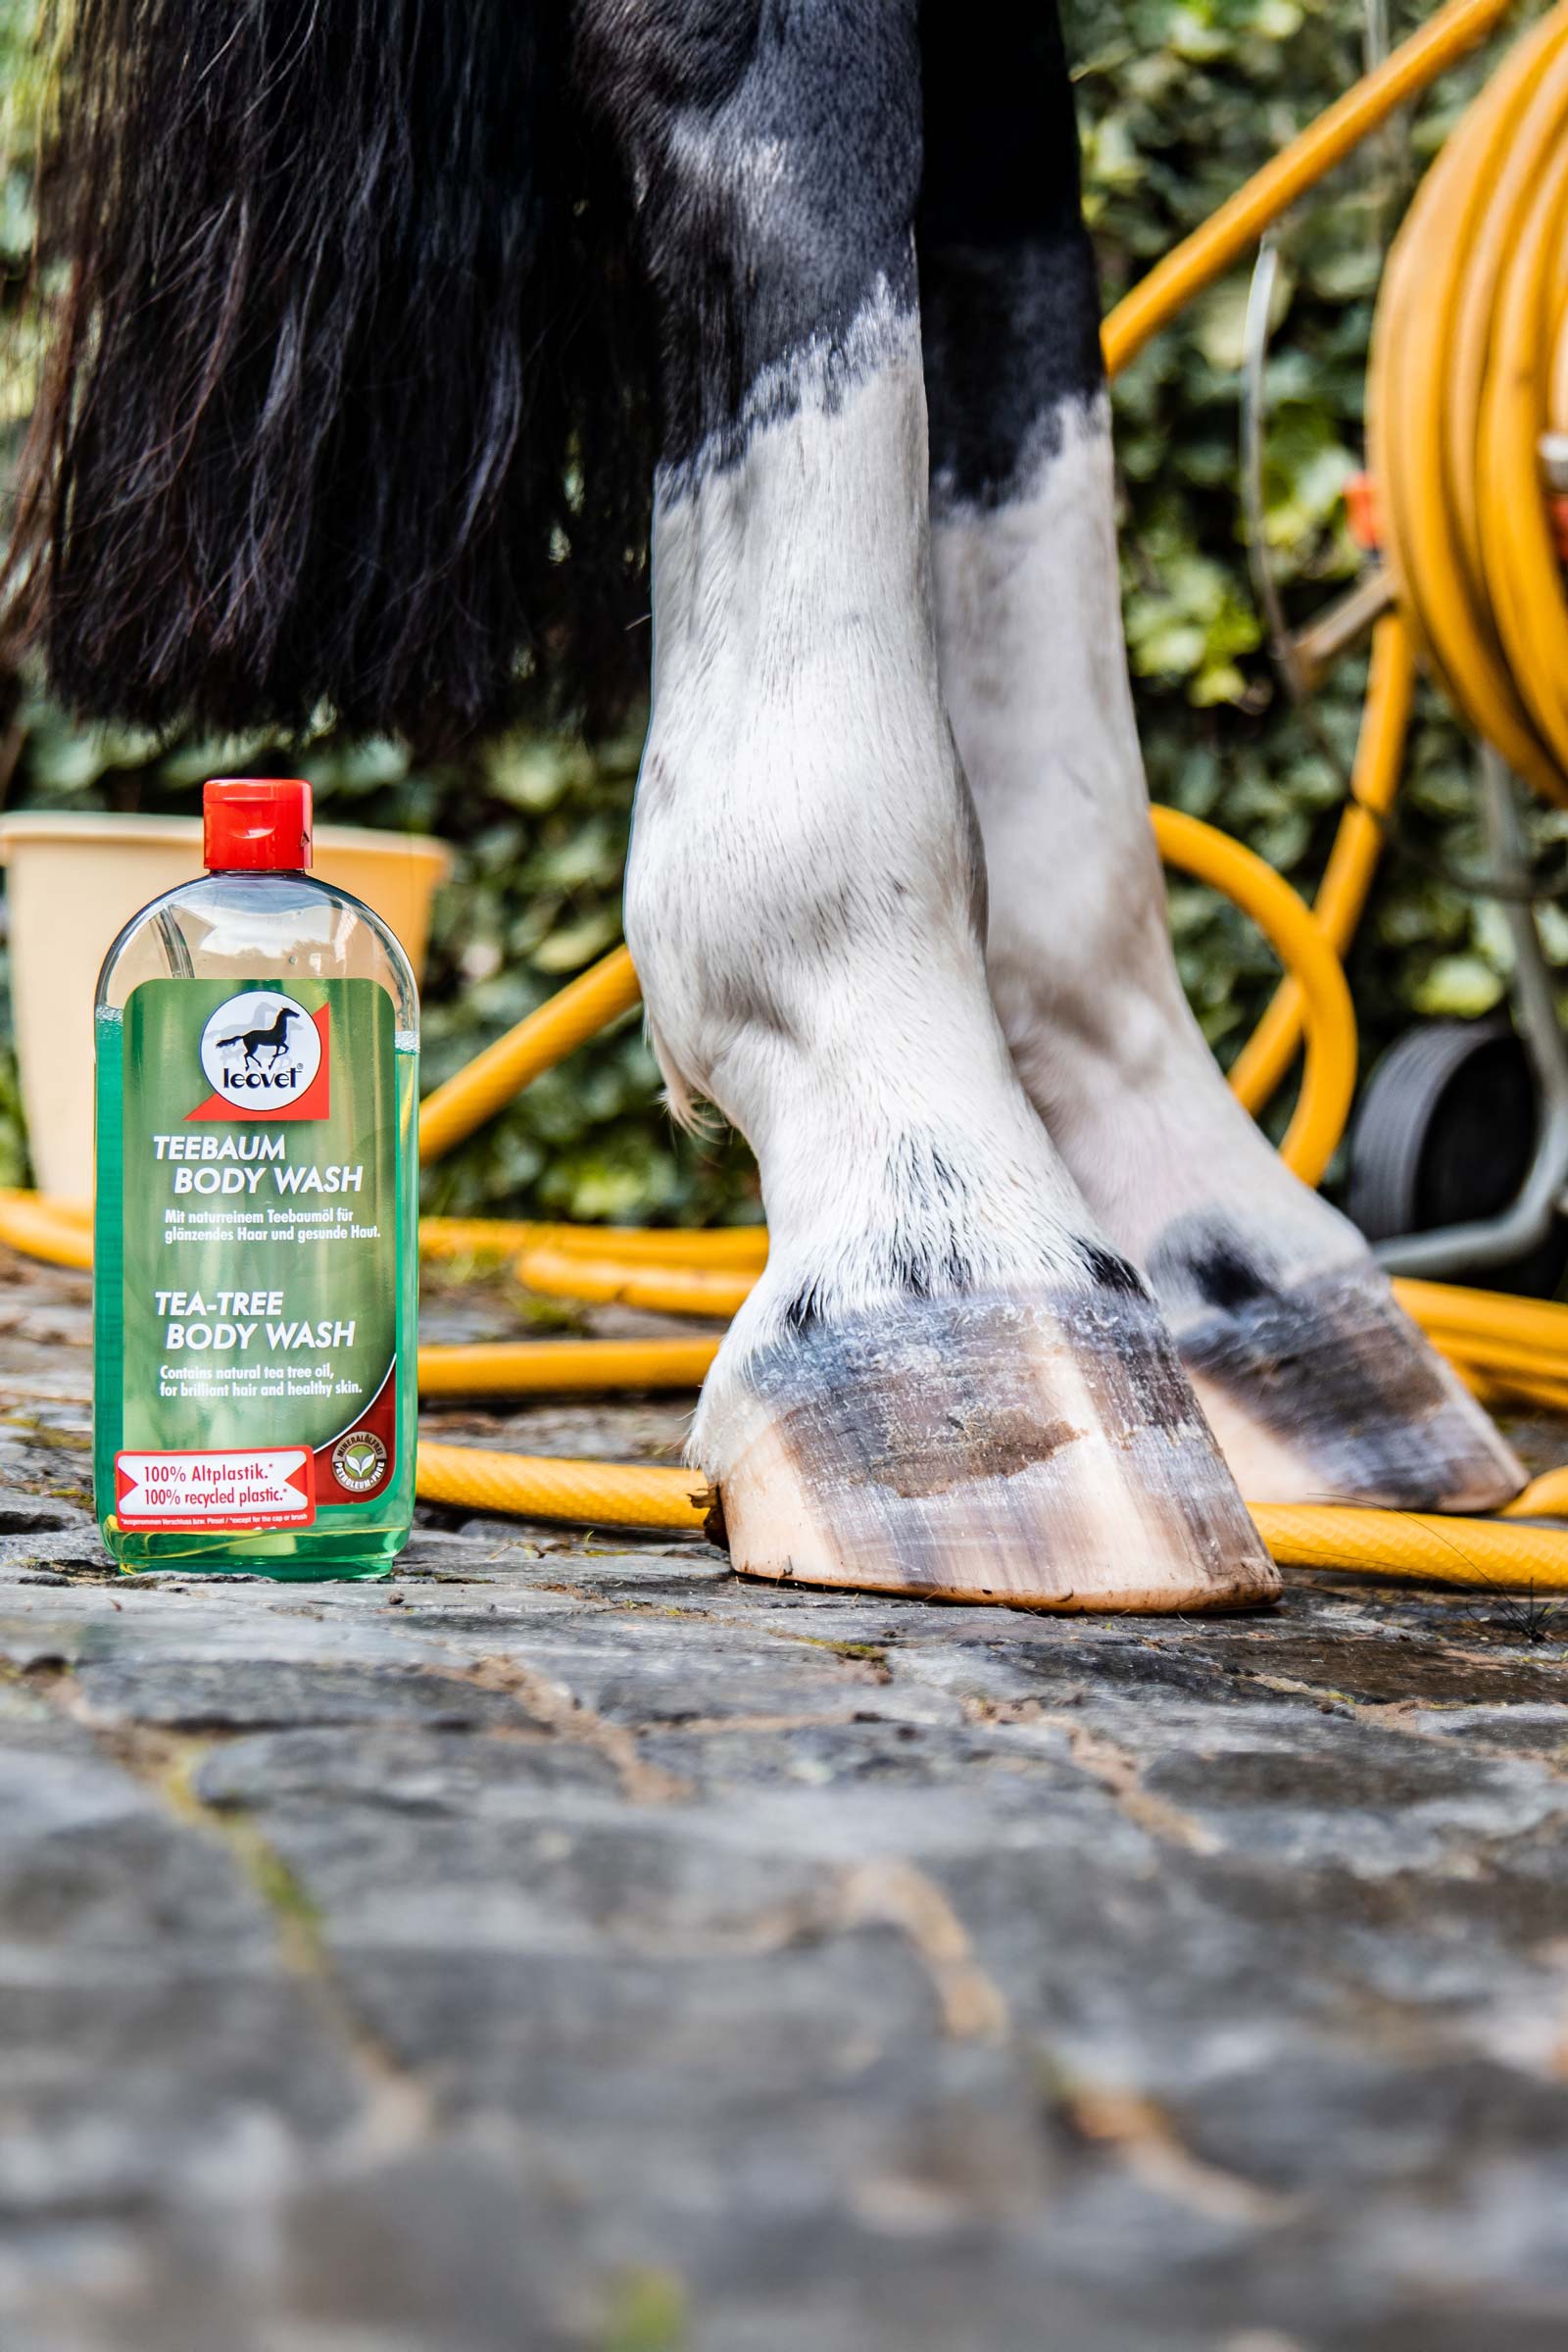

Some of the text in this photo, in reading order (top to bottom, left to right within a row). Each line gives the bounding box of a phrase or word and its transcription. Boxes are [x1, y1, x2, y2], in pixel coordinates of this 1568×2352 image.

[154, 1135, 286, 1160] TEEBAUM
[173, 1165, 364, 1195] BODY WASH
[165, 1207, 354, 1224] Mit naturreinem Teebaumöl für
[165, 1224, 380, 1245] glänzendes Haar und gesunde Haut.
[155, 1291, 284, 1316] TEA-TREE
[166, 1321, 356, 1350] BODY WASH
[160, 1362, 334, 1380] Contains natural tea tree oil,
[160, 1379, 363, 1397] for brilliant hair and healthy skin.
[144, 1466, 186, 1483] 100%
[144, 1488, 180, 1505] 100%
[184, 1487, 234, 1508] recycled
